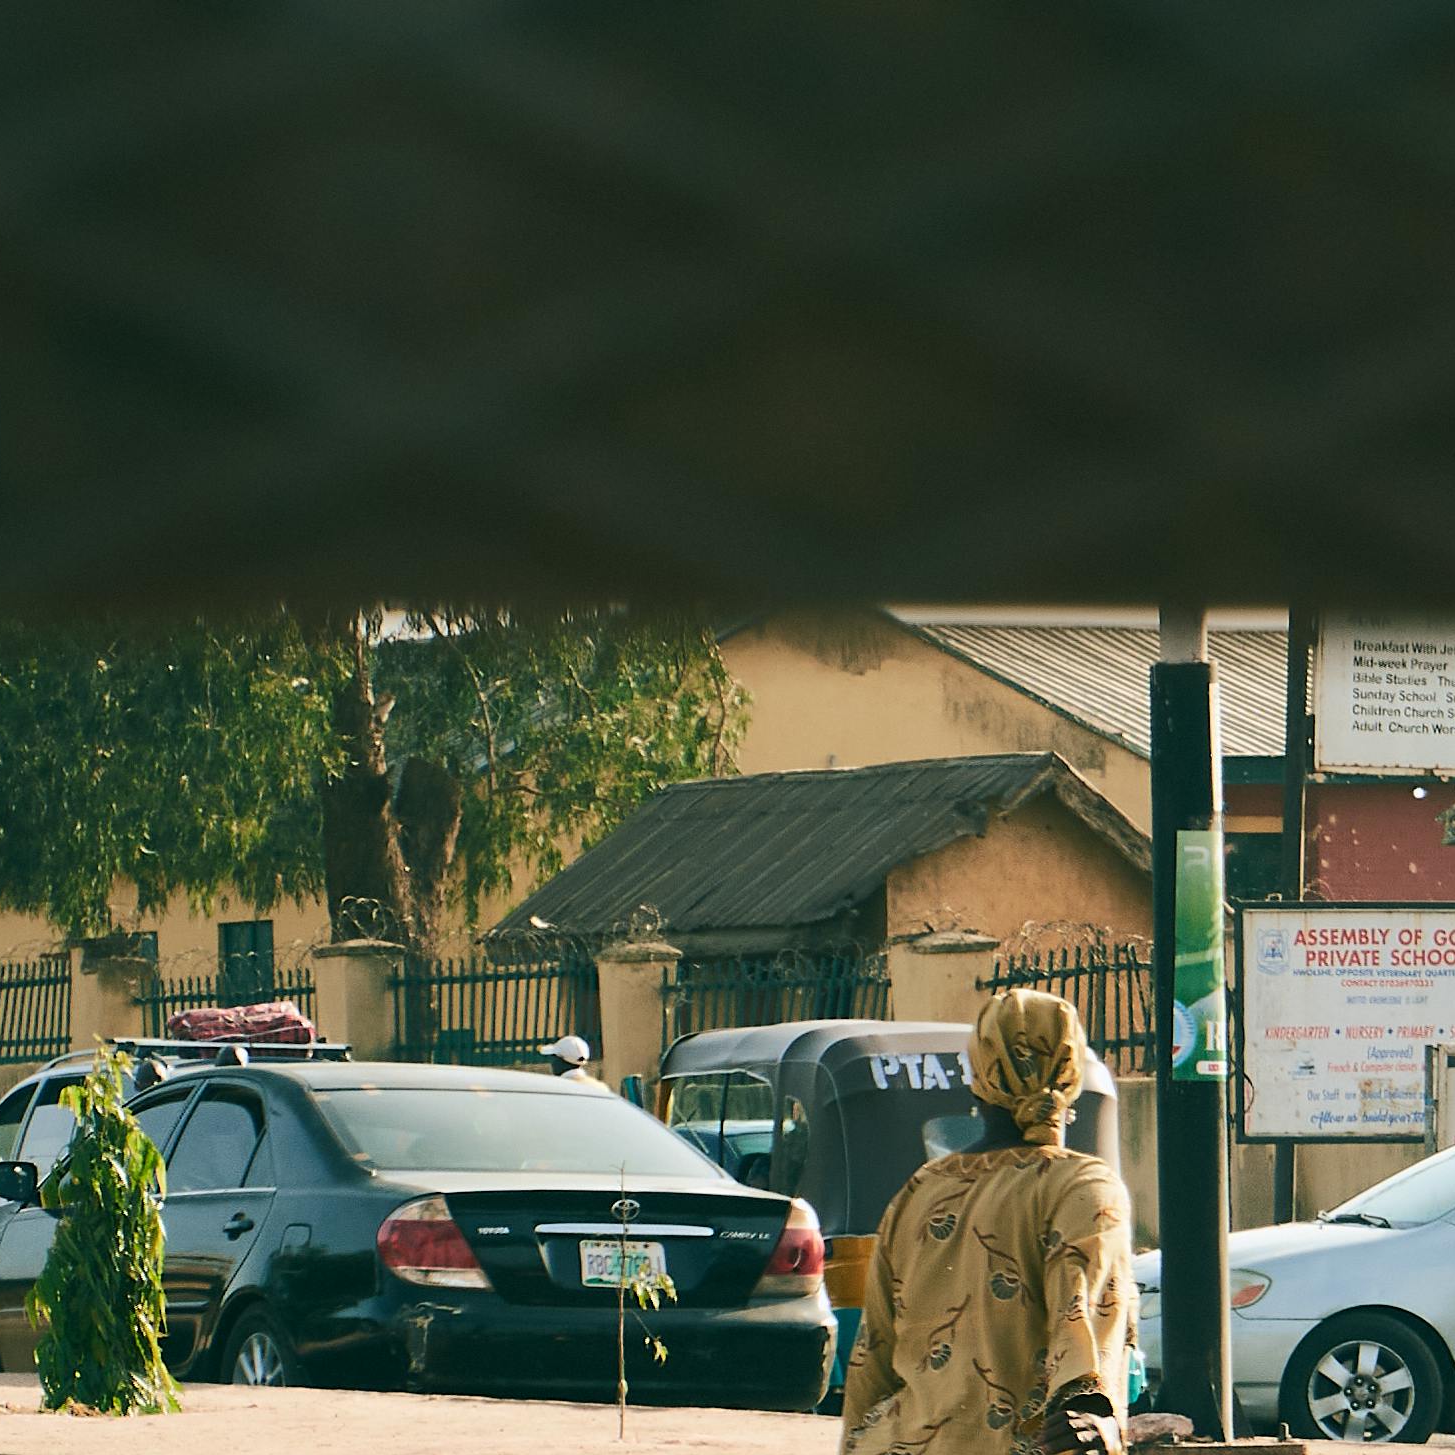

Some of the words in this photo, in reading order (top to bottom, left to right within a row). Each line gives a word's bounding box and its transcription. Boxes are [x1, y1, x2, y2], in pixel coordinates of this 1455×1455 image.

[1353, 640, 1410, 654] Breakfast
[1411, 641, 1437, 655] With
[1353, 656, 1407, 669] Mid-week
[1411, 659, 1448, 673] Prayer
[1353, 673, 1382, 685] Bible
[1386, 674, 1427, 686] Studies
[1352, 688, 1395, 702] Sunday
[1399, 690, 1437, 702] School
[1352, 704, 1400, 717] Children
[1404, 706, 1444, 719] Church
[1352, 721, 1383, 733] Adult
[1388, 721, 1429, 734] Church
[1294, 929, 1390, 947] ASSEMBLY
[1398, 930, 1422, 947] OF
[1305, 949, 1381, 967] PRIVATE
[1335, 969, 1374, 977] OPPOSITE
[1264, 1025, 1330, 1040] KINDERGARTEN
[1345, 1026, 1384, 1040] NURSERY
[1397, 1026, 1435, 1039] PRIMARY
